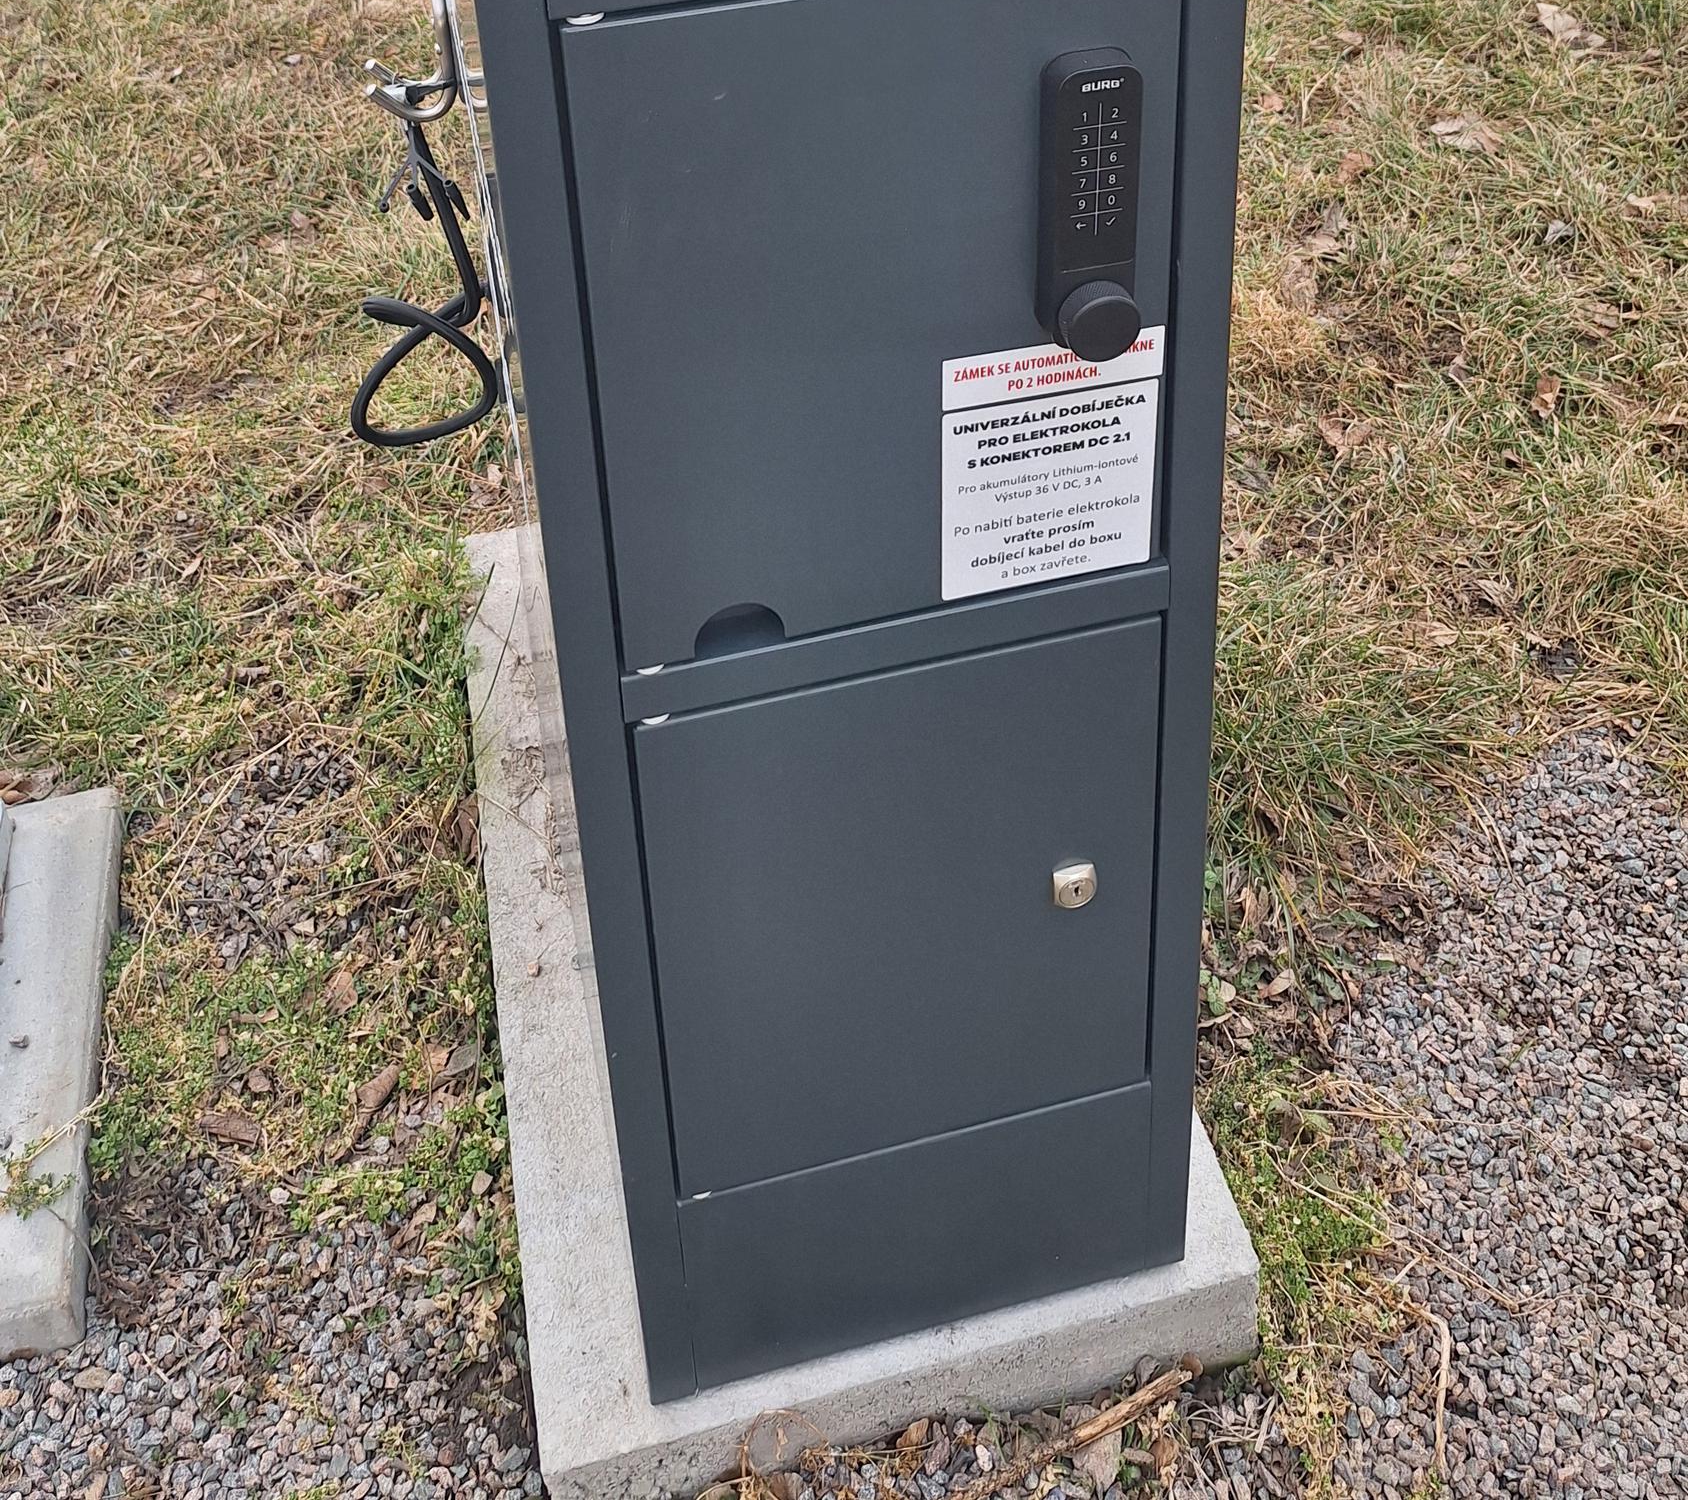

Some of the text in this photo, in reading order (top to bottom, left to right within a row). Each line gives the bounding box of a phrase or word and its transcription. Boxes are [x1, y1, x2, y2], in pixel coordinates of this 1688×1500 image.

[1082, 107, 1119, 123] 1 2
[1081, 130, 1119, 145] 3 4
[1080, 152, 1118, 167] 5 6
[1079, 174, 1116, 189] 7 8
[1078, 195, 1116, 210] 9 0
[954, 352, 1083, 383] ZÁMEK SE AUTOMATIC
[1008, 365, 1101, 391] PO 2 HODINÁCH.
[953, 393, 1146, 435] UNIVERZÁLNÍ DOBÍJEČKA
[977, 416, 1121, 450] PRO ELEKTROKOLA
[967, 431, 1130, 469] S KONEKTOREM DC 2.1
[958, 453, 1139, 495] Pro akumulátory Lithium-iontové
[994, 475, 1102, 503] Výstup 36 V DC, 3 A
[954, 493, 1140, 537] Po nabití baterie elektrokola
[1003, 519, 1095, 545] vraťte prosím
[971, 532, 1122, 568] dobíjecí kabel do boxu
[1001, 555, 1091, 579] a box zavřete.
